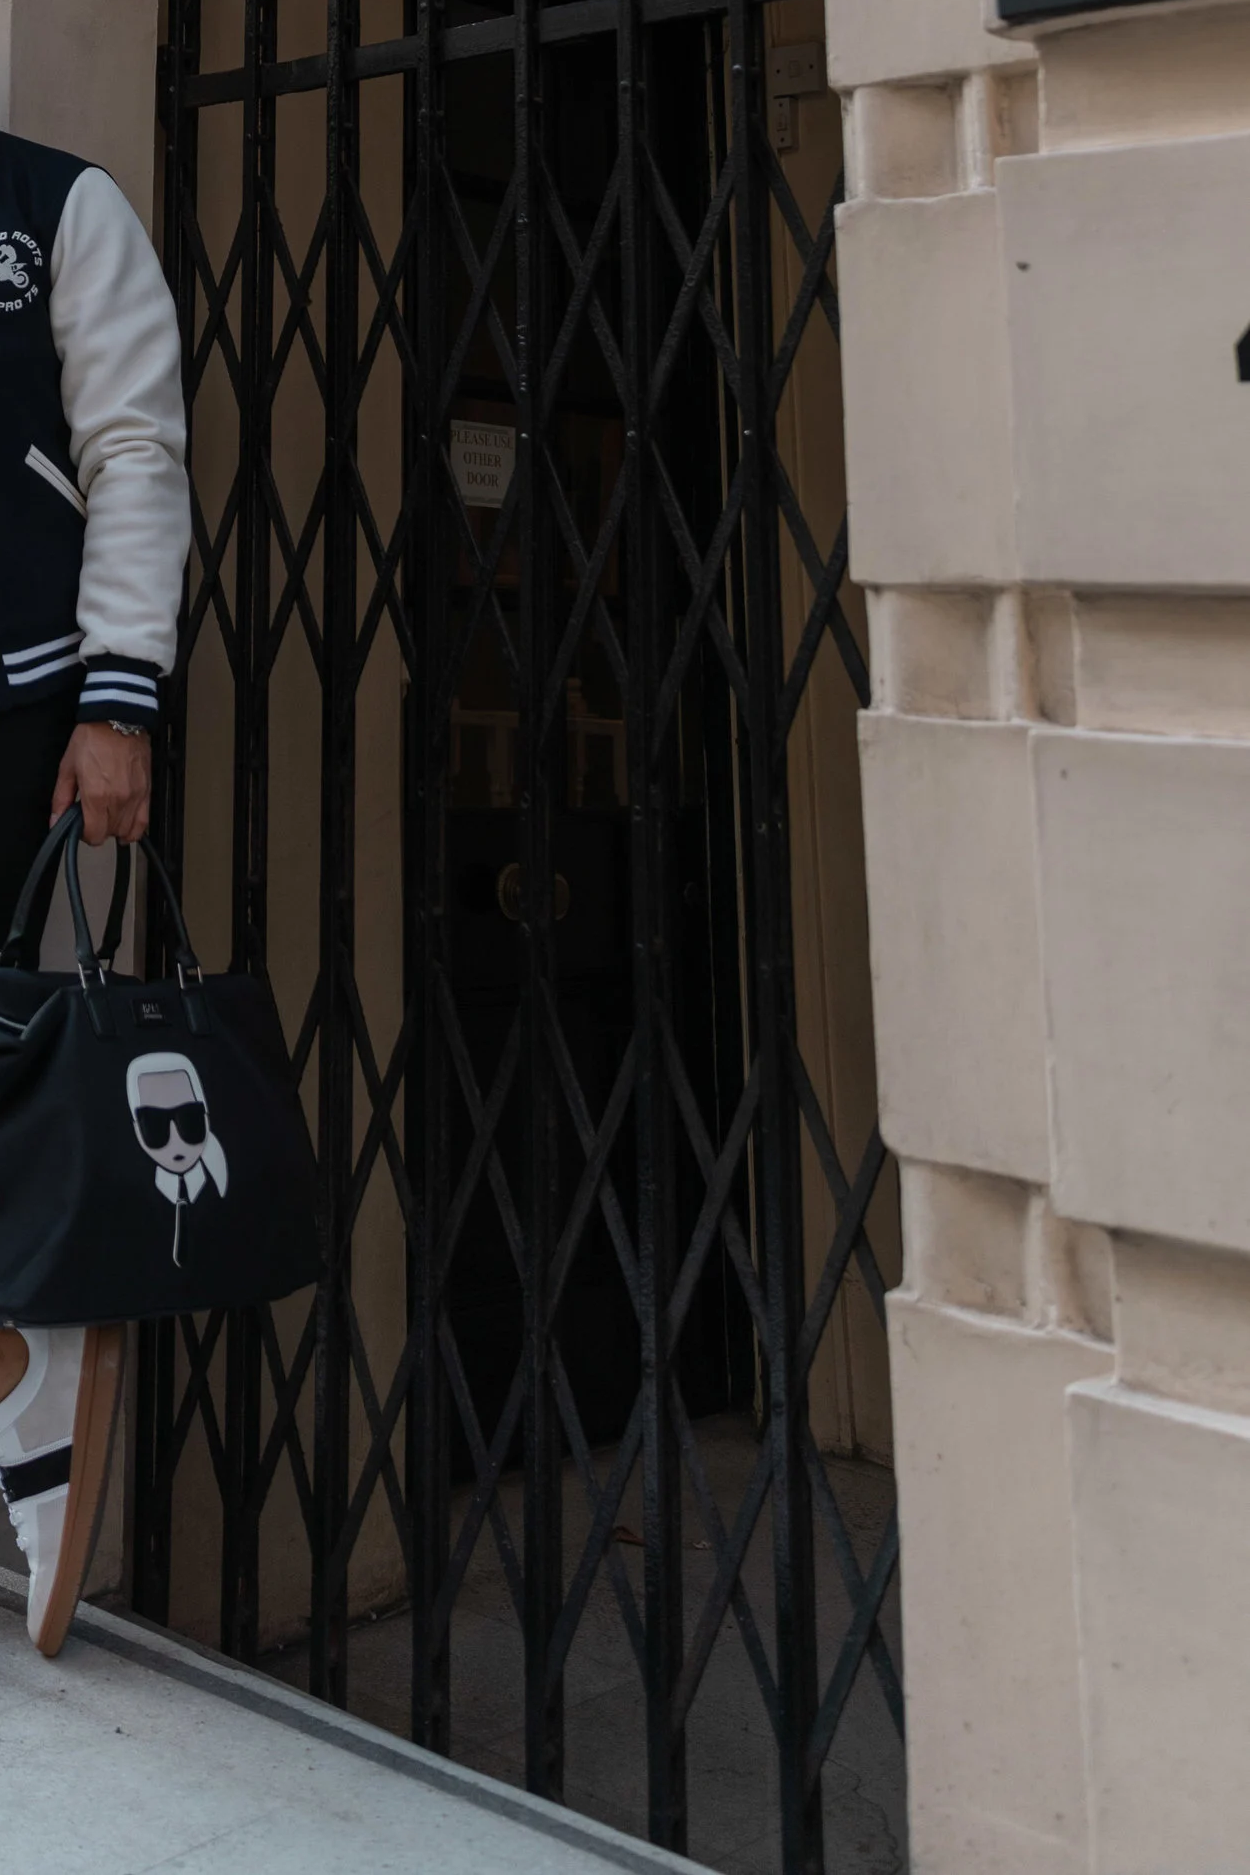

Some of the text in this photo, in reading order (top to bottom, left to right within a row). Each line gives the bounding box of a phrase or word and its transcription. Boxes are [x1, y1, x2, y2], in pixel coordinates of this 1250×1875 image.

[11, 230, 43, 267] ROOTS
[24, 284, 39, 303] 75
[451, 429, 492, 447] PLEASE
[463, 451, 502, 468] OTHER
[467, 471, 500, 488] DOOR
